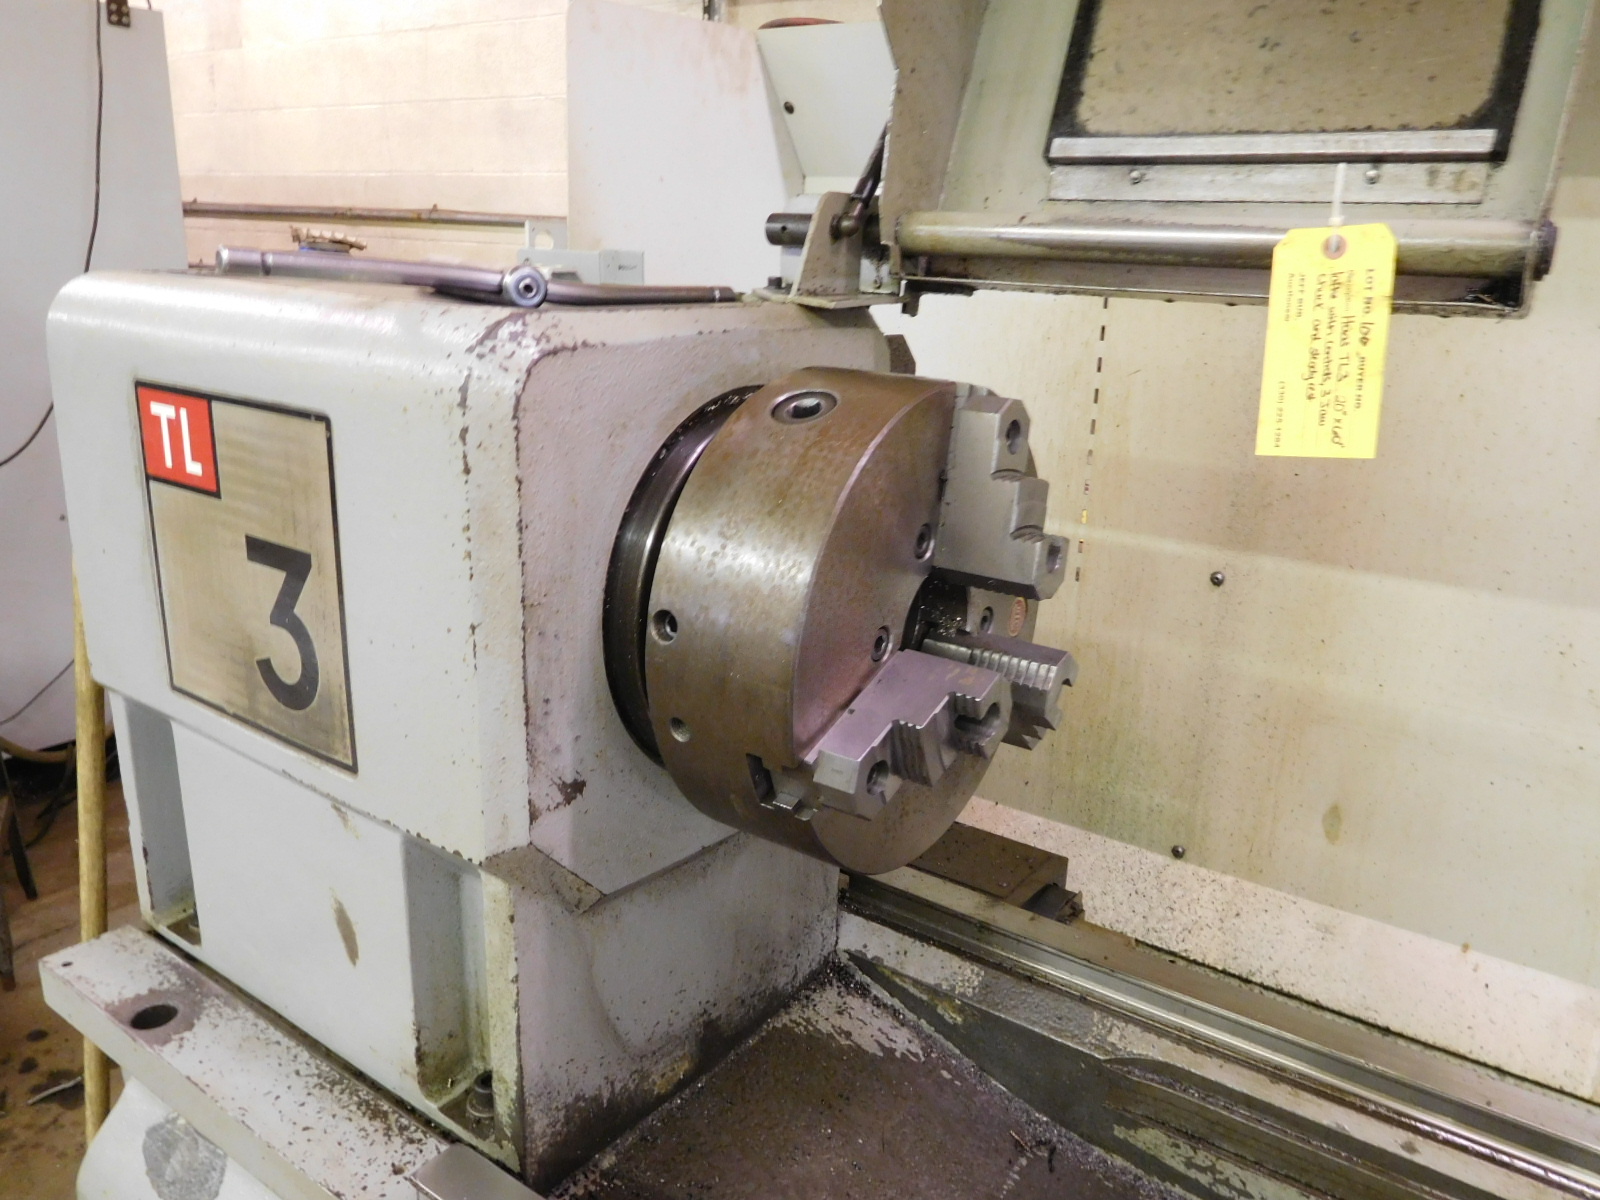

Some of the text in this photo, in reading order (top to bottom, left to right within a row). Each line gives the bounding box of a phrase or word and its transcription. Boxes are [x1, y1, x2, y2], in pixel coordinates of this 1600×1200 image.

[1363, 268, 1375, 290] LOT
[1310, 318, 1322, 341] and
[1340, 315, 1356, 347] Haas
[1337, 355, 1350, 382] TL3
[1356, 356, 1366, 391] BUYER
[1320, 389, 1331, 398] 3
[150, 400, 203, 477] TL
[244, 534, 320, 712] 3
